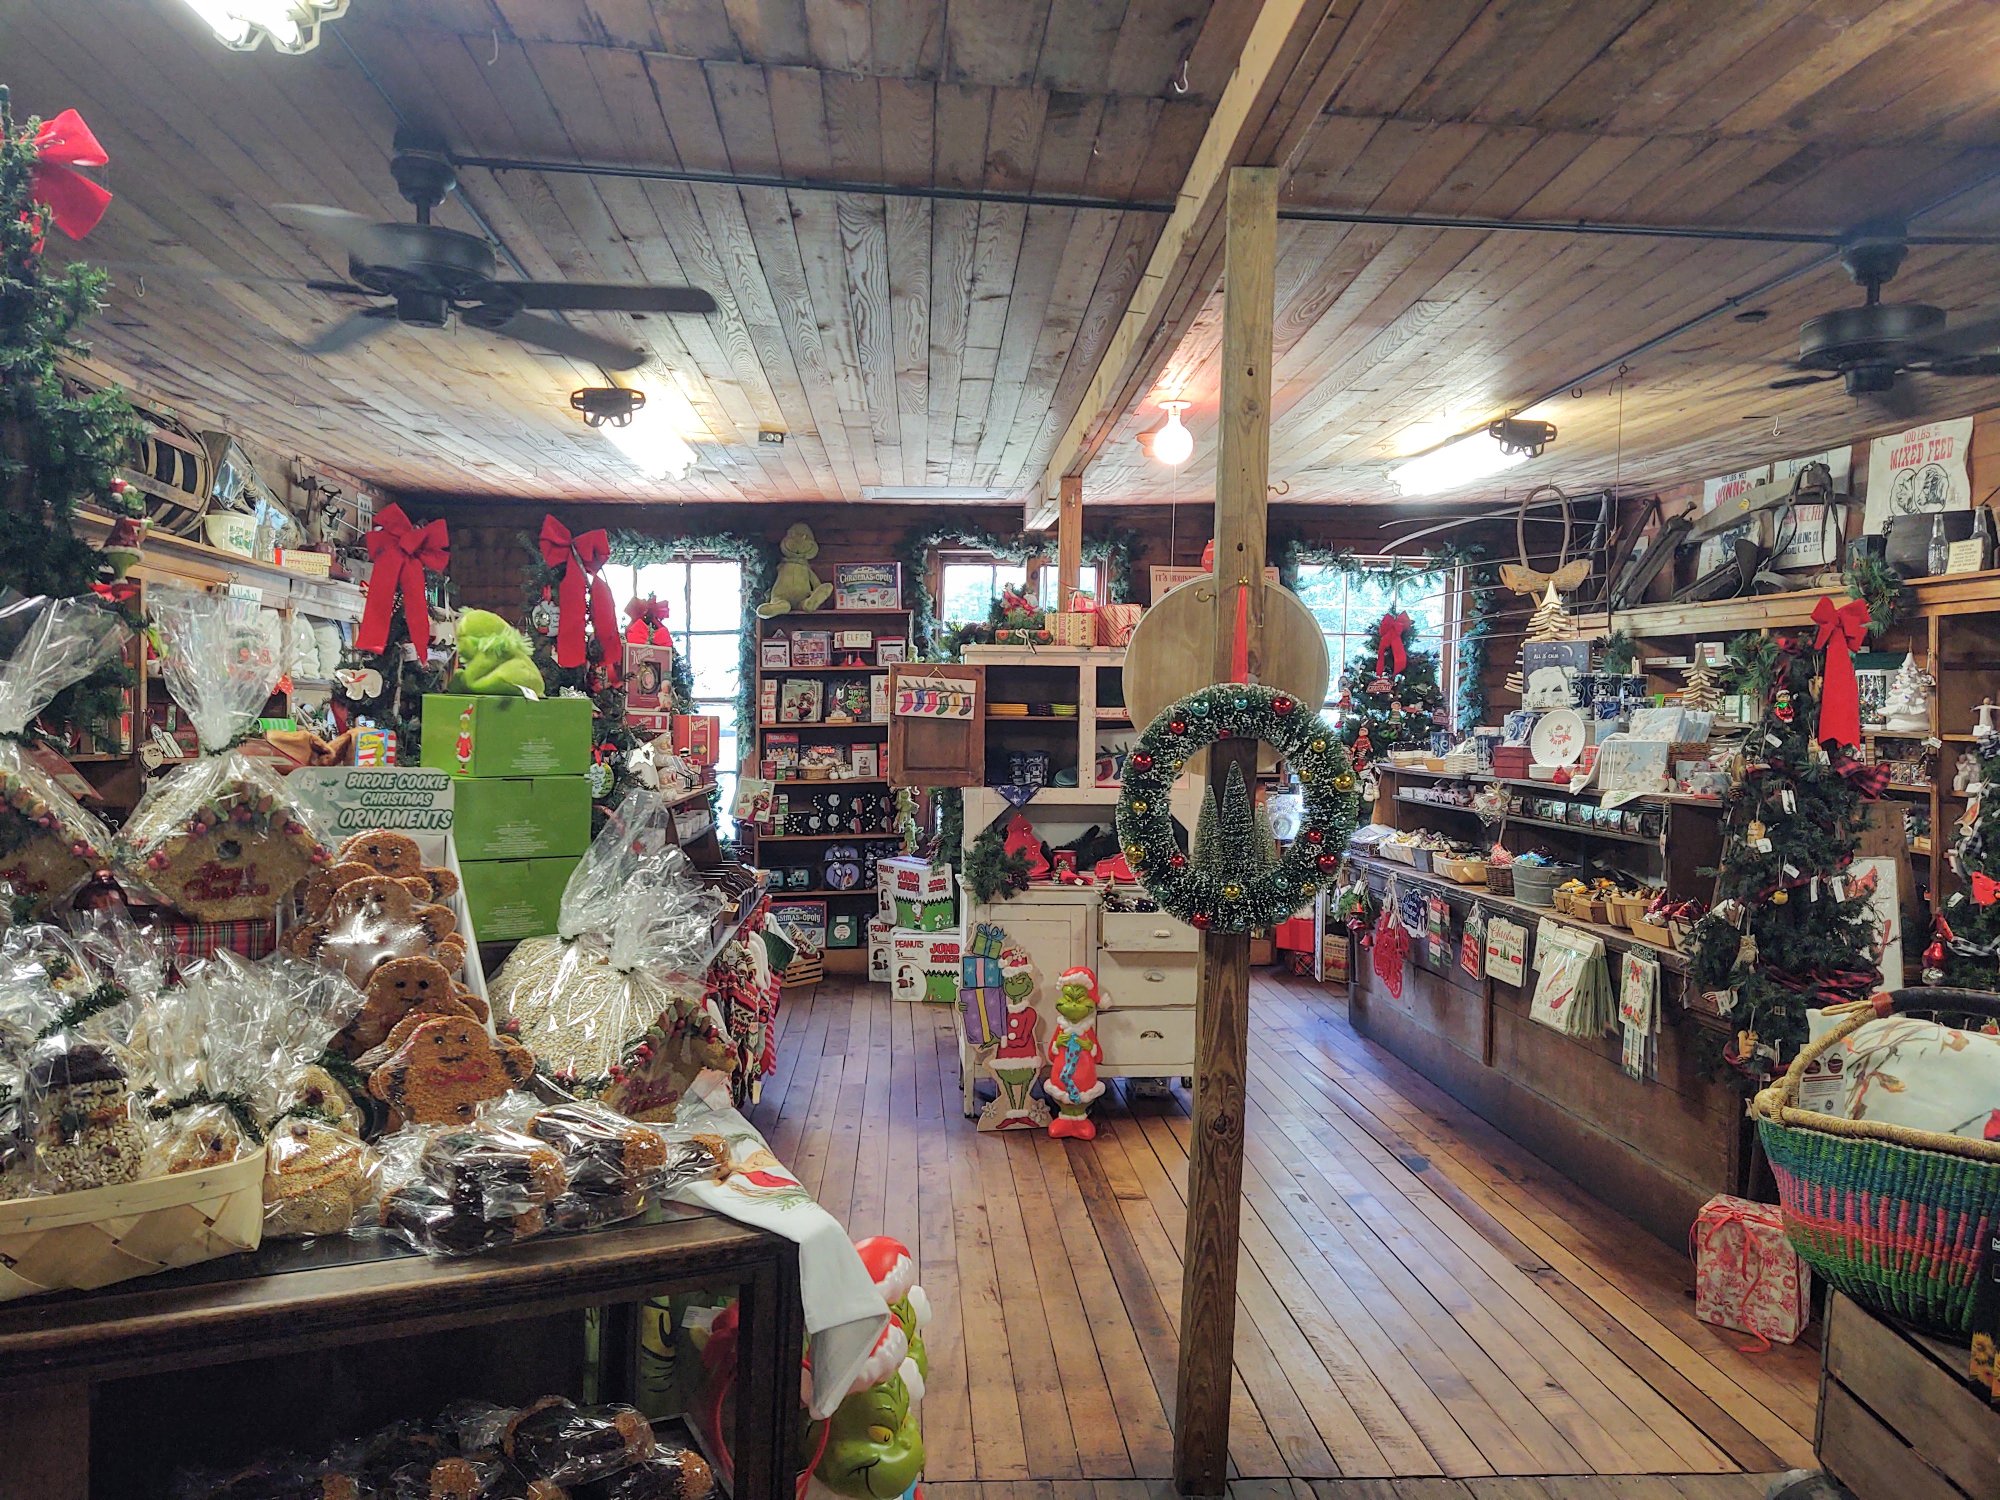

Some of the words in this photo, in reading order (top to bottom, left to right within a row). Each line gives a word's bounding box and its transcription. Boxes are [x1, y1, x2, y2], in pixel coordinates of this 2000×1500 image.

[1890, 442, 1924, 471] MIXED
[1927, 437, 1954, 462] FEED
[1738, 472, 1747, 480] NET
[345, 772, 393, 790] BIRDIE
[396, 773, 451, 790] COOKIE
[361, 791, 434, 807] CHRISTMAS
[337, 807, 453, 829] ORNAMENTS
[870, 924, 891, 932] PEANU
[1489, 922, 1522, 945] Christmas
[895, 940, 924, 949] PEANUTS
[929, 942, 960, 955] JUMB
